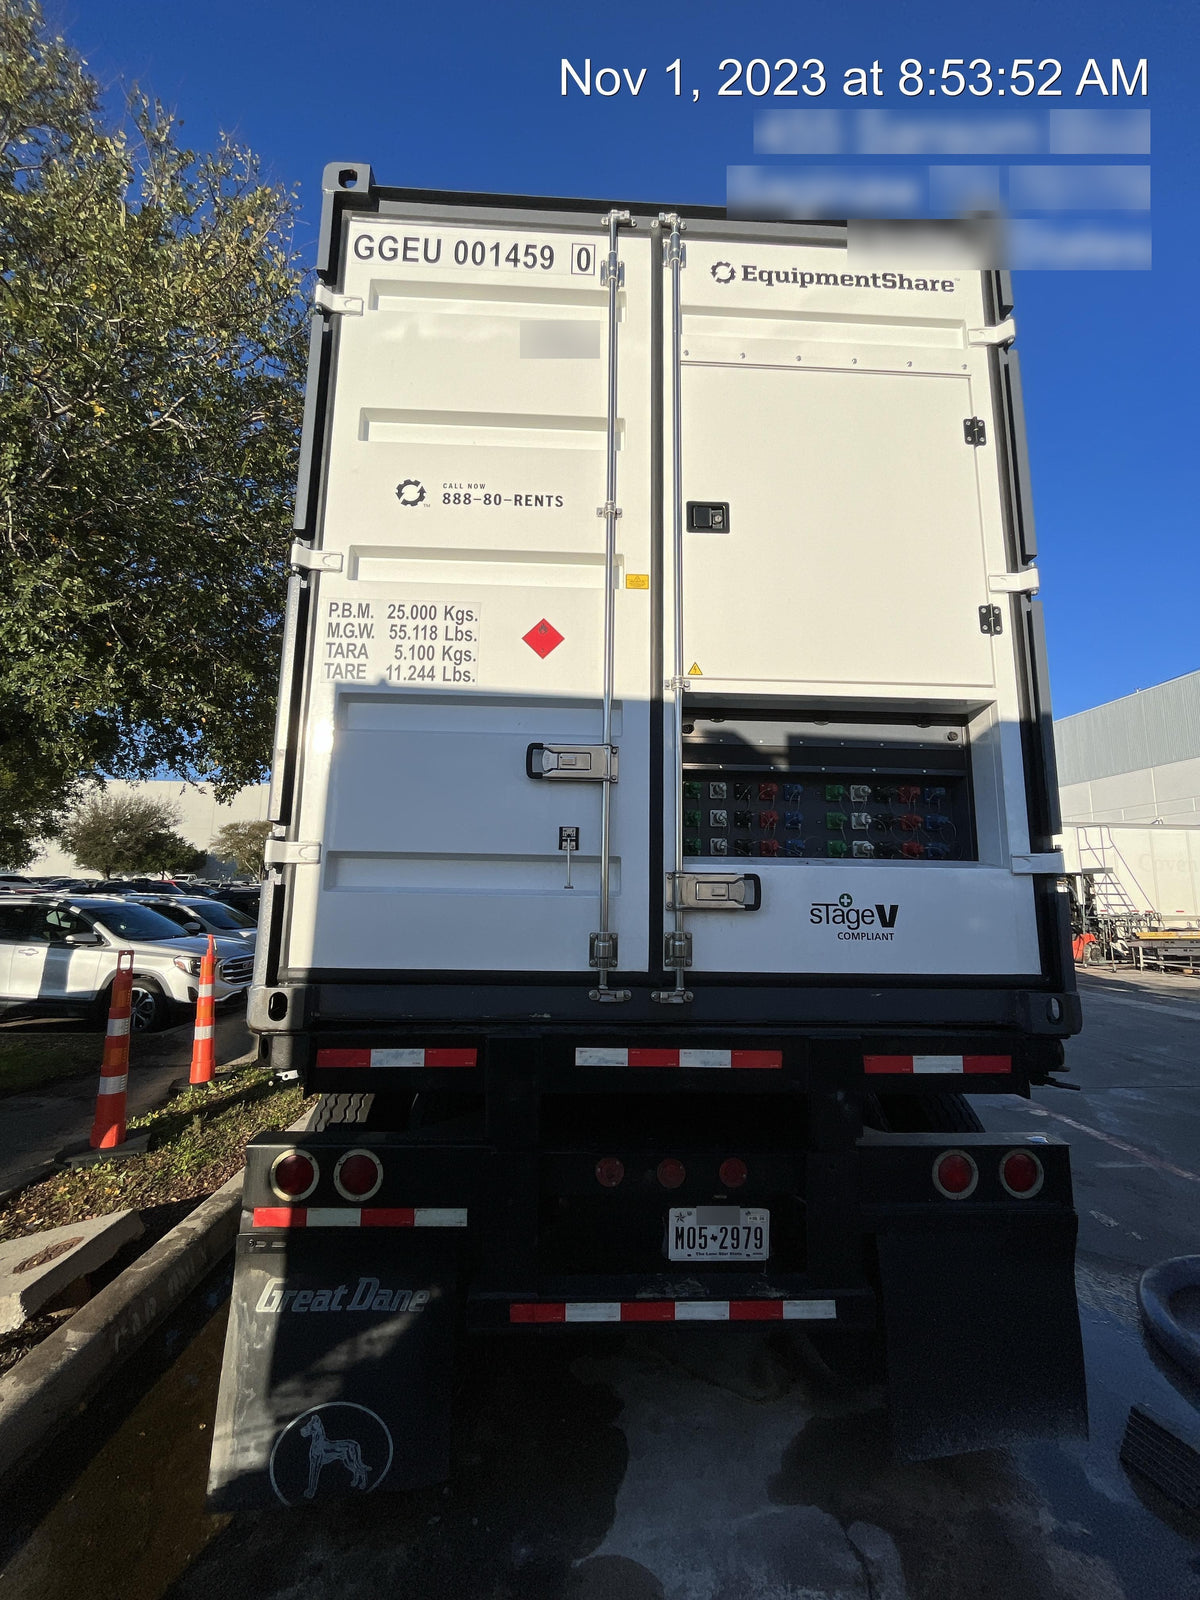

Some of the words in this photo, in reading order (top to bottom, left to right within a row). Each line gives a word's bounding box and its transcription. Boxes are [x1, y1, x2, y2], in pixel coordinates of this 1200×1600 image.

[353, 234, 442, 264] GGEU
[453, 239, 555, 270] 001459
[576, 246, 592, 273] 0
[741, 264, 956, 294] EquipmentShare
[442, 482, 464, 490] CALL
[442, 492, 564, 508] 888-80-RENTS
[328, 602, 374, 619] P.B.M.
[387, 604, 437, 620] 25.000
[443, 605, 479, 626] Kgs.
[327, 622, 375, 639] M.G.W.
[389, 624, 438, 641] 55.118
[444, 625, 478, 642] Lbs.
[325, 642, 369, 659] TARA
[394, 644, 435, 661] 5.100
[442, 645, 477, 666] Kgs.
[324, 662, 367, 680] TARE
[385, 664, 436, 681] 11.244
[442, 666, 476, 683] Lbs.
[837, 931, 895, 941] COMPLIANT
[255, 1277, 350, 1313] Great
[346, 1277, 432, 1313] Dane
